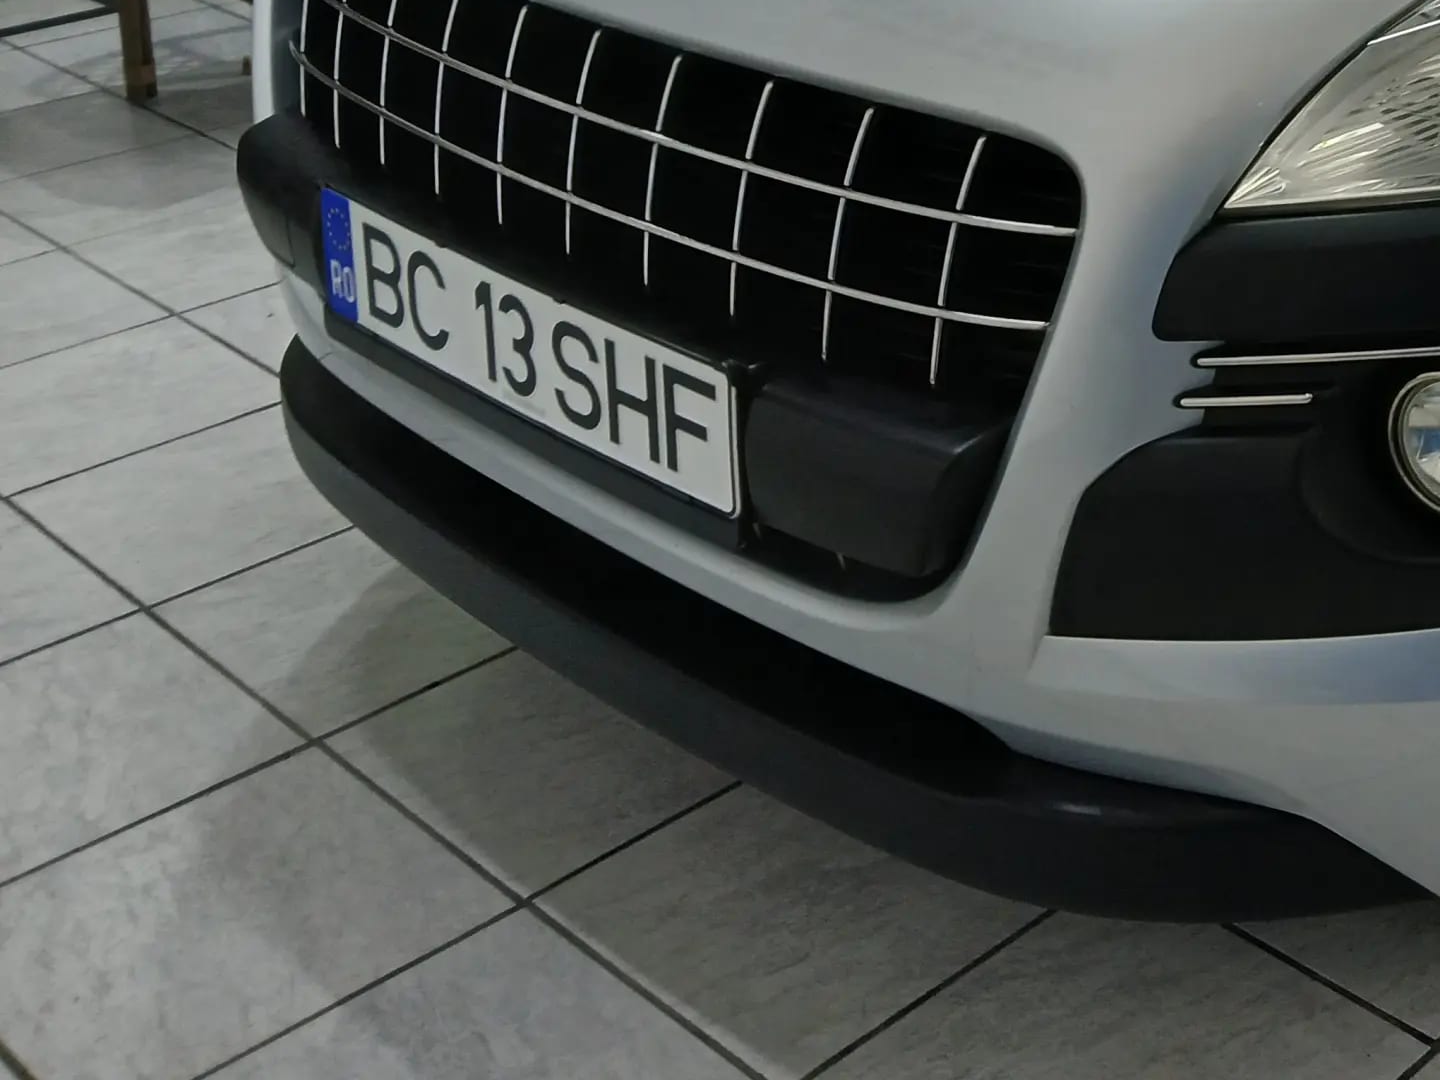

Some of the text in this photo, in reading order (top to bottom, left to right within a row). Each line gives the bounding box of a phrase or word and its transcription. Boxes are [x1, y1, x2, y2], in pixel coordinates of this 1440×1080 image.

[330, 258, 355, 303] RO
[362, 222, 717, 473] BC 13 SHF
